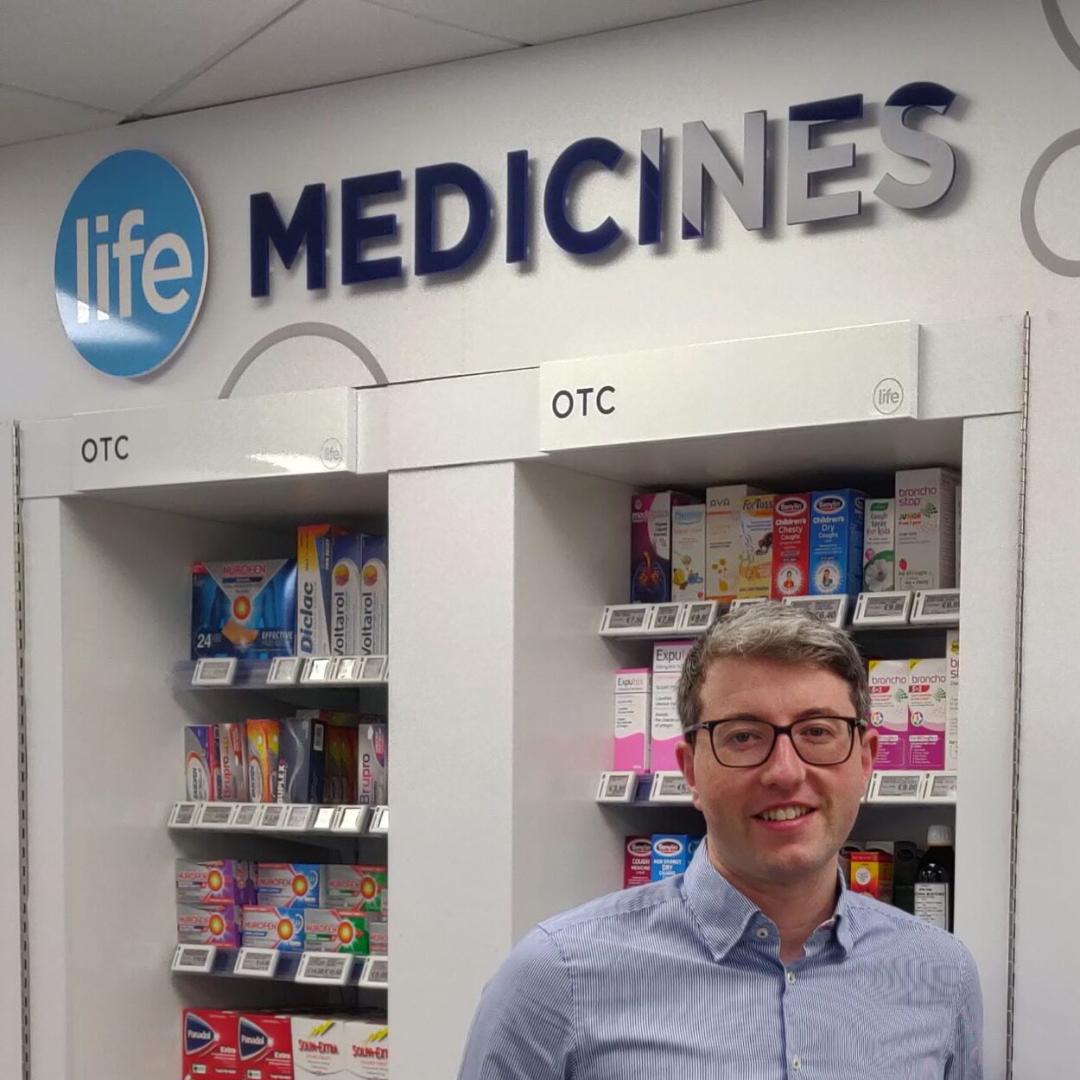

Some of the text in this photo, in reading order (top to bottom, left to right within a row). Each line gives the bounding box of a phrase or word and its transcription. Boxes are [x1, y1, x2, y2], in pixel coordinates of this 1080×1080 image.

[249, 81, 957, 299] MEDICINES
[74, 208, 191, 324] life
[551, 386, 616, 419] OTC
[877, 384, 900, 407] life
[81, 436, 129, 463] OTC
[322, 443, 343, 461] life
[300, 582, 315, 655] Diclac
[196, 634, 212, 649] 24
[912, 674, 946, 684] broncho
